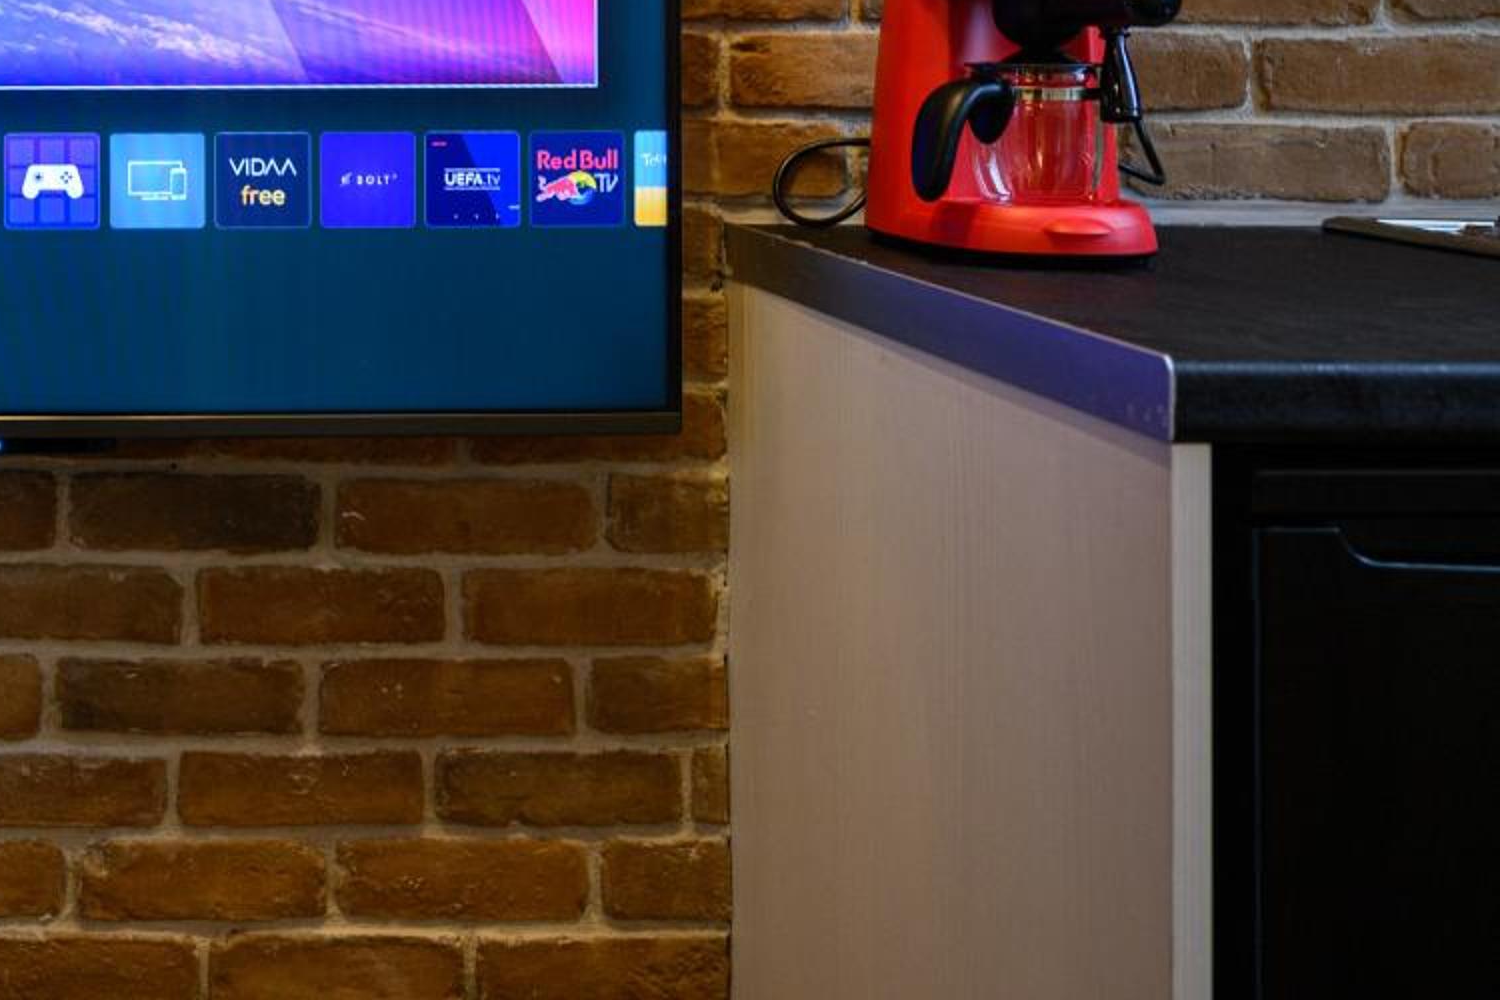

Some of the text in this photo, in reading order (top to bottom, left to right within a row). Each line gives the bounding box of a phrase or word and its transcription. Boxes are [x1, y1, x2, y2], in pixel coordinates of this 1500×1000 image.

[537, 148, 577, 169] Red
[580, 148, 619, 169] Bull
[594, 173, 619, 193] TV
[241, 184, 286, 206] free
